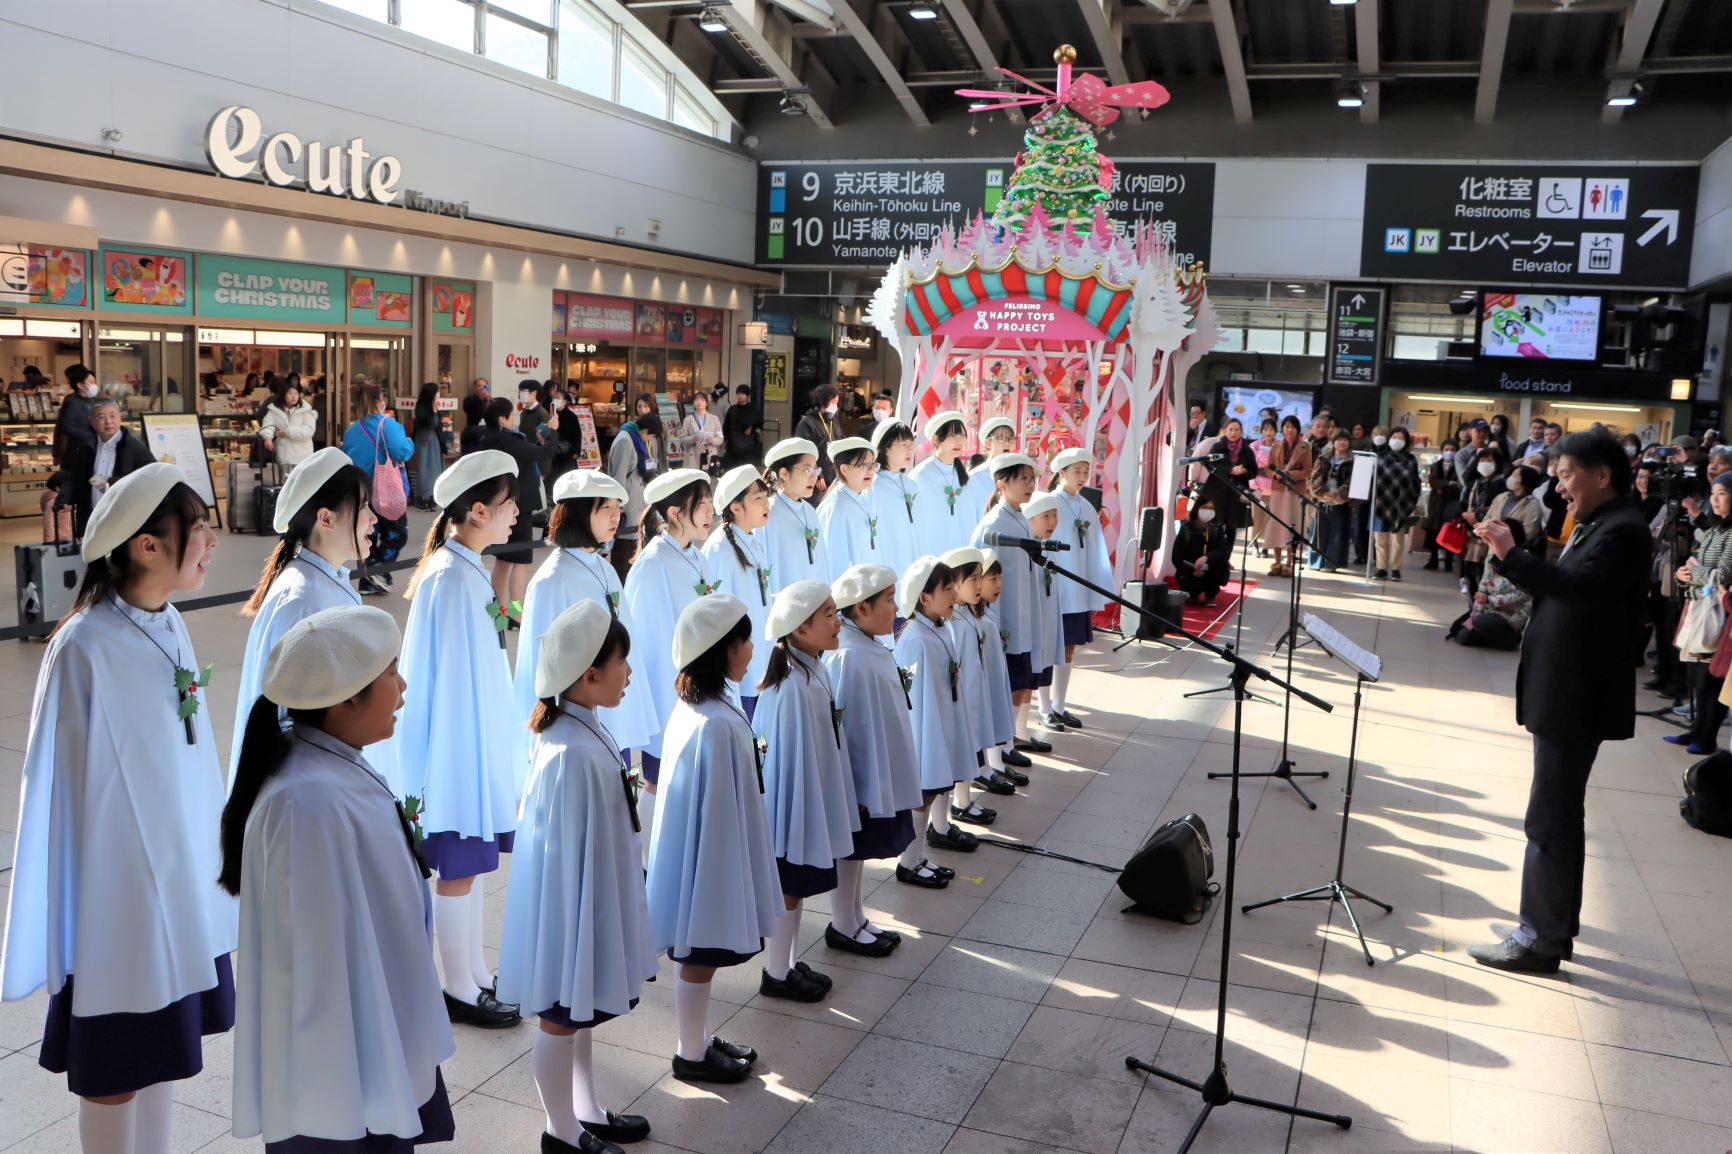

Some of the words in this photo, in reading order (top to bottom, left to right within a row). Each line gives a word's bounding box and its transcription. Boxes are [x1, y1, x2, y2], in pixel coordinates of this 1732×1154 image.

[206, 104, 402, 204] ecute
[773, 175, 783, 184] JK
[833, 171, 945, 195] 京浜東北線
[989, 173, 1000, 182] JY
[802, 171, 820, 202] 9
[1459, 176, 1533, 201] 化粧室
[833, 198, 928, 212] Keihin-Tōhoku
[932, 198, 961, 212] Line
[1132, 198, 1164, 212] Line
[1455, 204, 1531, 219] Restrooms
[771, 222, 782, 231] JY
[792, 217, 824, 247] 10
[832, 217, 942, 242] 山手線(外回り
[1389, 233, 1406, 247] JK
[1418, 233, 1436, 248] JY
[1448, 231, 1575, 254] エレベーター
[832, 244, 898, 258] Yamanote
[1512, 258, 1573, 273] Elevator
[217, 271, 274, 290] CLAP
[278, 276, 329, 295] YOUR
[214, 287, 331, 311] CHRISTMAS
[1004, 302, 1041, 310] FELISSIMO
[572, 304, 600, 318] CLAP
[603, 307, 631, 320] YOUR
[989, 311, 1024, 321] HAPPY
[1027, 312, 1055, 322] TOYS
[1339, 305, 1351, 316] 11
[570, 317, 632, 332] CHRISTMAS
[996, 322, 1047, 333] PROJECT
[1336, 343, 1350, 354] 12
[505, 353, 540, 368] ecute
[1500, 372, 1531, 391] food
[1531, 379, 1572, 392] stand
